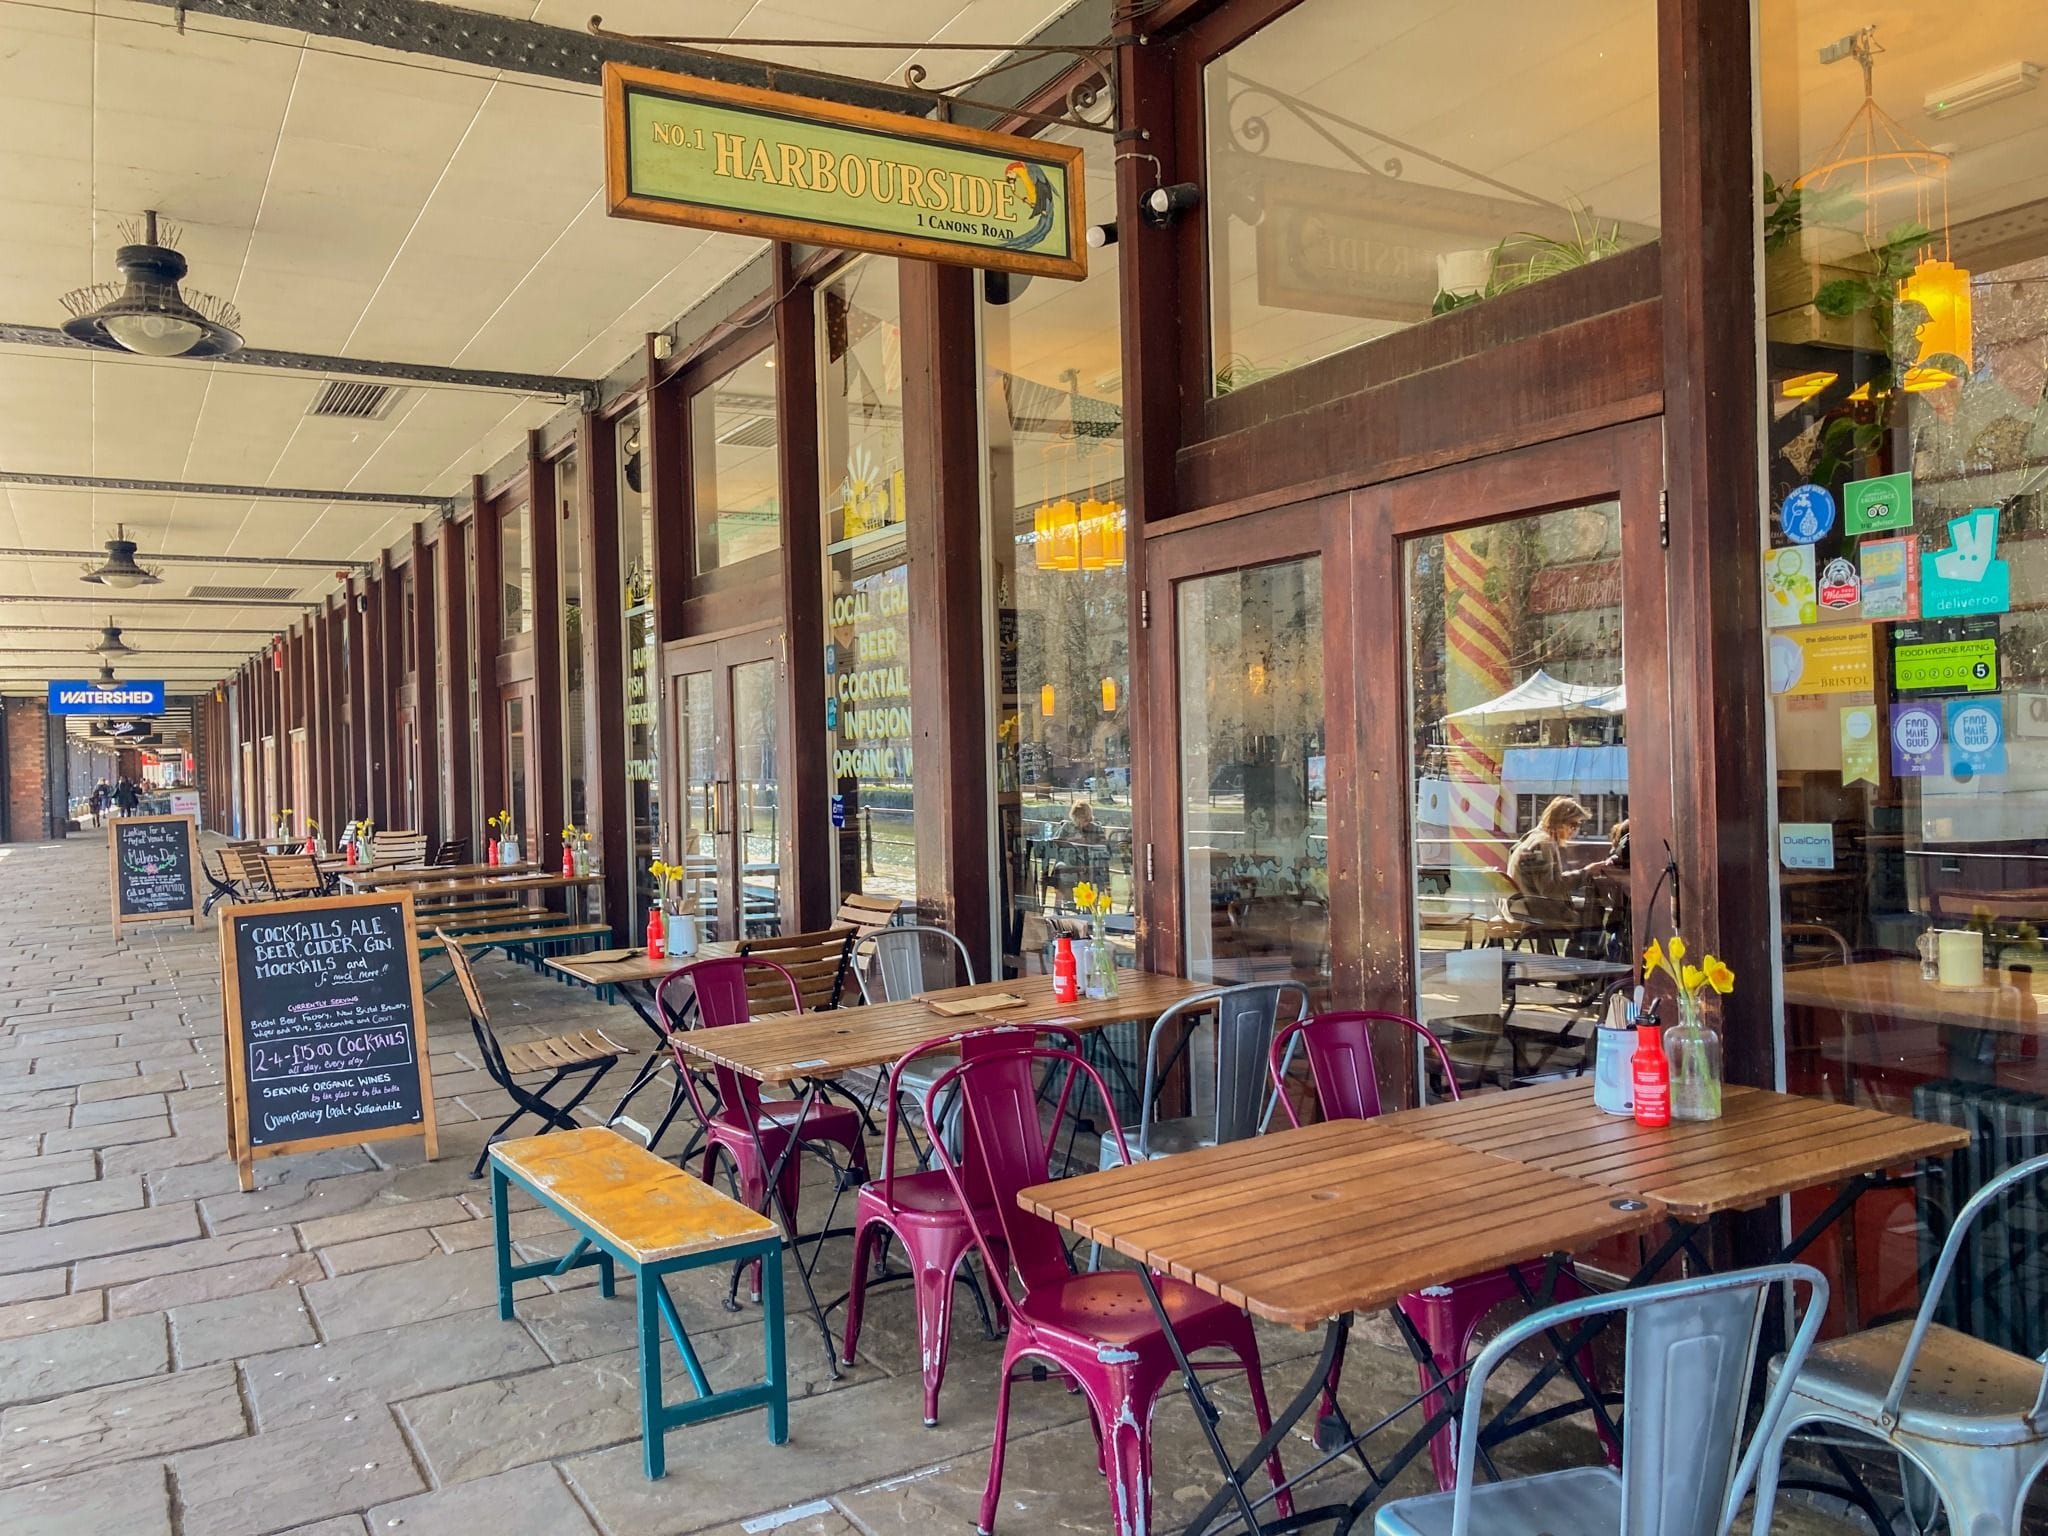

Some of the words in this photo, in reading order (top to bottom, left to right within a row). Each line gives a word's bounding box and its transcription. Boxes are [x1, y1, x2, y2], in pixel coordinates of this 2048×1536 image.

[712, 131, 1017, 222] HARBOURSIDE
[917, 213, 923, 227] 1
[1937, 595, 1998, 610] deliveroo
[829, 592, 871, 628] LOCAL
[859, 627, 897, 660] BEER
[1900, 649, 1923, 657] FOOD
[1925, 646, 1959, 655] HYGIENE
[1960, 644, 1990, 653] RATING
[1976, 664, 1986, 678] 5
[1821, 676, 1869, 688] BRISTOL
[60, 691, 153, 704] WATERSHED
[1906, 718, 1928, 728] FOOD
[1963, 715, 1987, 726] FOOD
[1906, 728, 1928, 738] MADE
[1963, 725, 1987, 736] MADE
[1906, 738, 1929, 747] GOOD
[1964, 736, 1988, 746] GOOD
[1784, 836, 1830, 845] DualCom
[255, 957, 336, 979] MOCKTAILS
[347, 957, 367, 969] and
[288, 1000, 326, 1012] CURRENTLY
[250, 1017, 276, 1030] Bristol
[337, 1031, 405, 1056] COCKTAILS
[288, 1064, 300, 1075] all
[324, 1059, 344, 1070] every
[263, 1083, 310, 1098] SERVING
[313, 1078, 354, 1092] ORGANIC
[358, 1073, 391, 1087] WINES
[264, 1108, 323, 1131] Championing
[326, 1103, 346, 1119] Local
[354, 1100, 402, 1116] Sustainable
